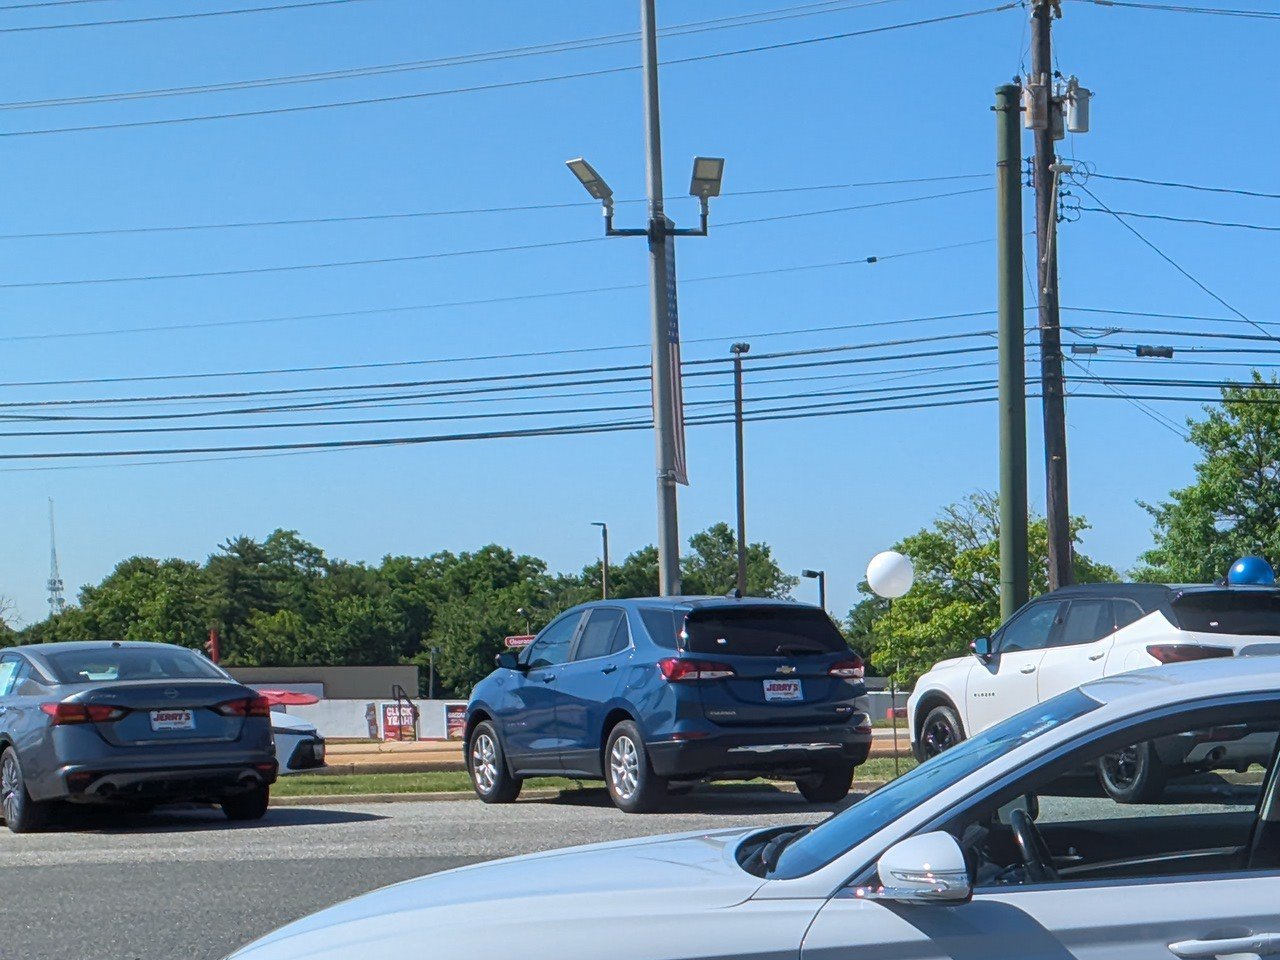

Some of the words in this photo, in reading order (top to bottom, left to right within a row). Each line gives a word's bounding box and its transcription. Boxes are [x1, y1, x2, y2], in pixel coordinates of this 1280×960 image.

[766, 683, 799, 692] JERRY'S
[386, 707, 412, 716] CLUCK
[153, 712, 191, 722] JERRY'S
